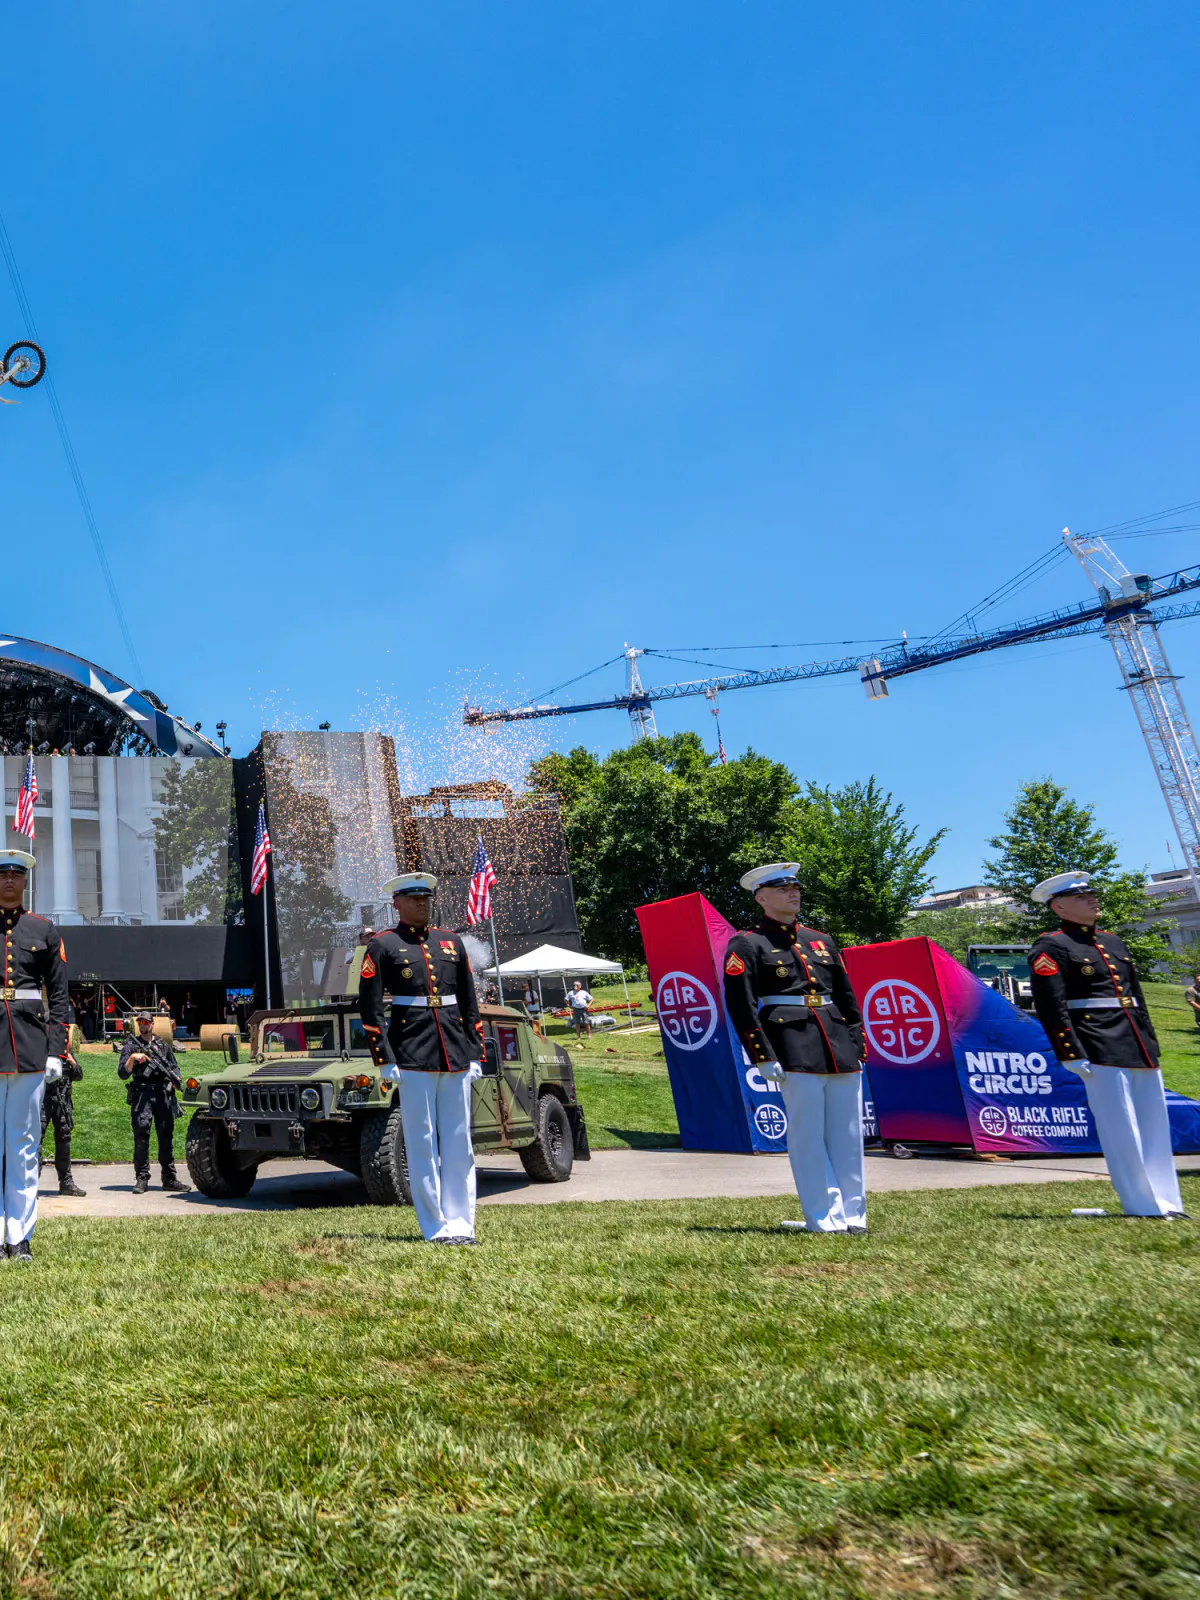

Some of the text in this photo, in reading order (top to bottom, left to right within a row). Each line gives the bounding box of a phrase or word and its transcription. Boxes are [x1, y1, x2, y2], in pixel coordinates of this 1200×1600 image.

[965, 1051, 1047, 1074] NITRO
[969, 1074, 1053, 1094] CIRCUS
[1006, 1106, 1088, 1123] BLACK RIFLE
[1011, 1125, 1088, 1137] COFFEE COMPANY
